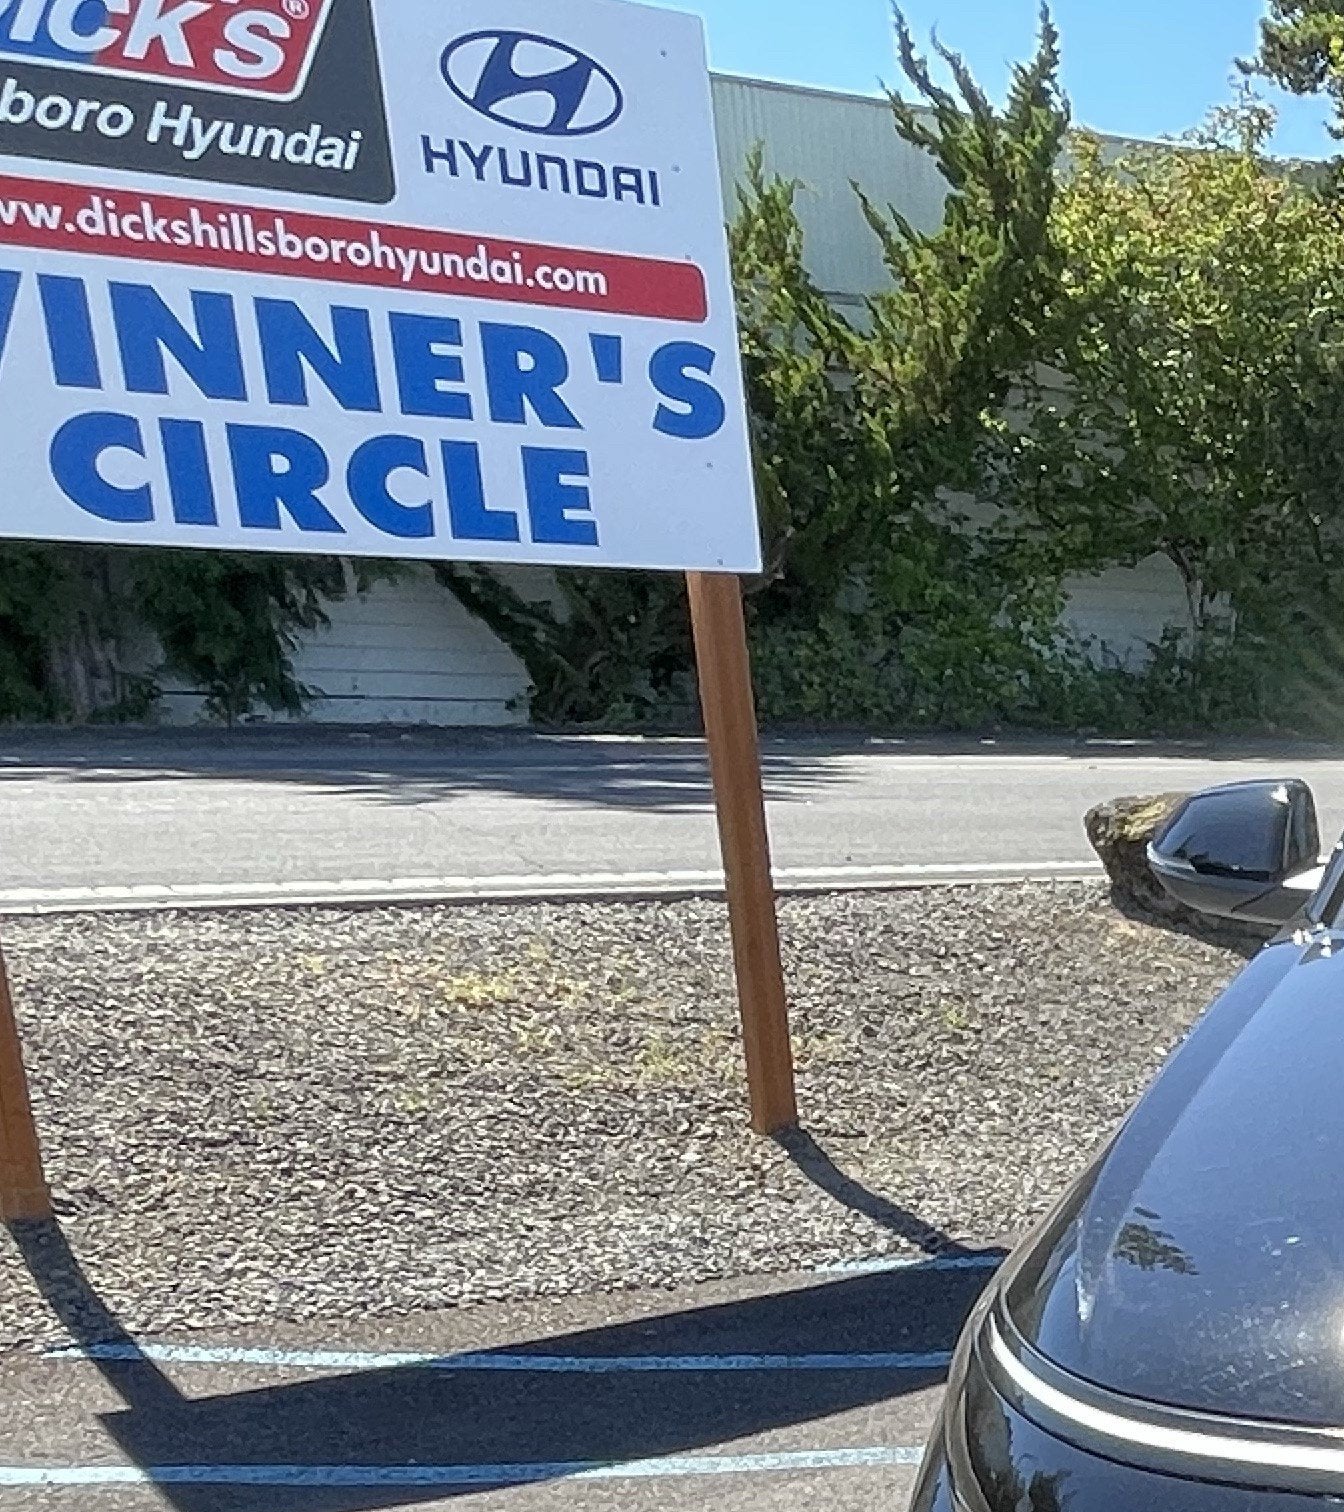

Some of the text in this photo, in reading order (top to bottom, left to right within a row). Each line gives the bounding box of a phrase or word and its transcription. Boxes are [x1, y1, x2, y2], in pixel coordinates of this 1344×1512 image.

[0, 78, 363, 171] boro Hyundai
[421, 135, 661, 206] HYUNDAI
[49, 411, 600, 547] CIRCLE
